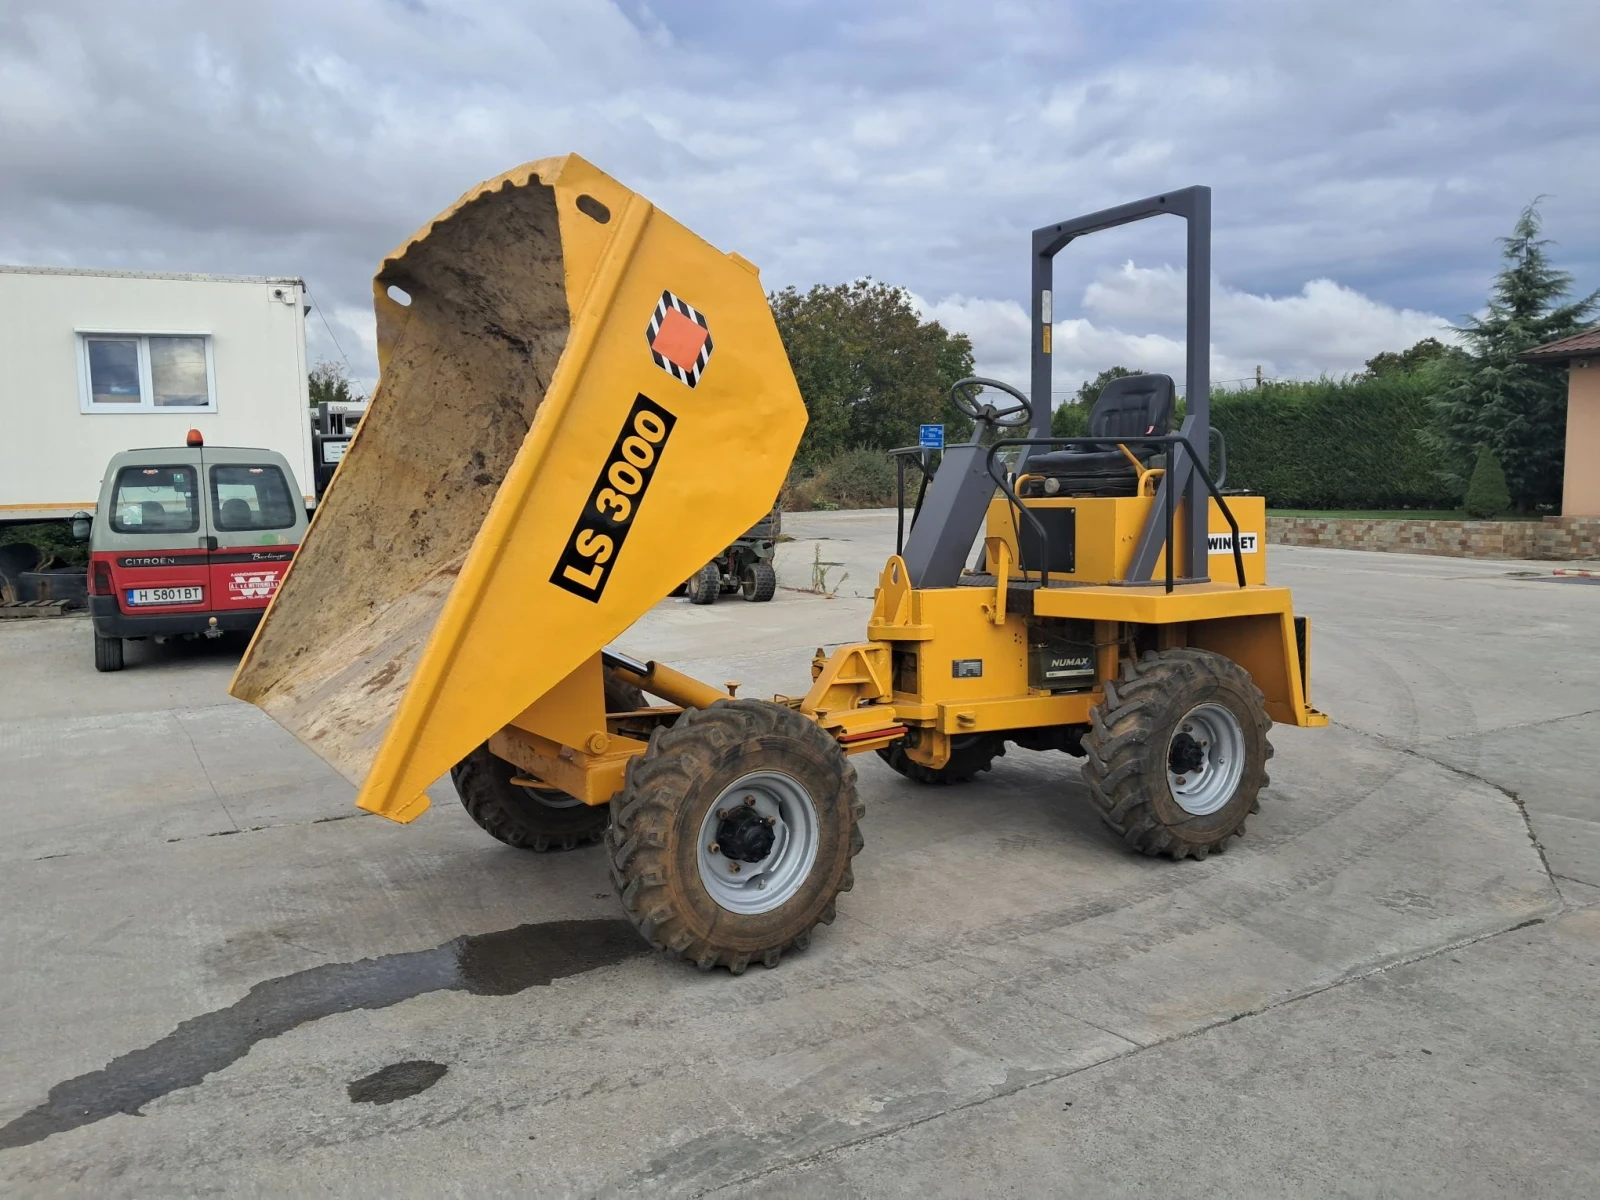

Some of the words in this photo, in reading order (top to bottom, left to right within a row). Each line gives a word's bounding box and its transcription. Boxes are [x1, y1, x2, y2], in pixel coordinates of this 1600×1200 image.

[562, 528, 613, 590] LS
[596, 410, 665, 521] 3000
[1207, 536, 1256, 550] WINET
[139, 590, 148, 601] H
[153, 589, 181, 601] 5801
[184, 588, 200, 599] BT
[1051, 657, 1089, 667] NUMAX
